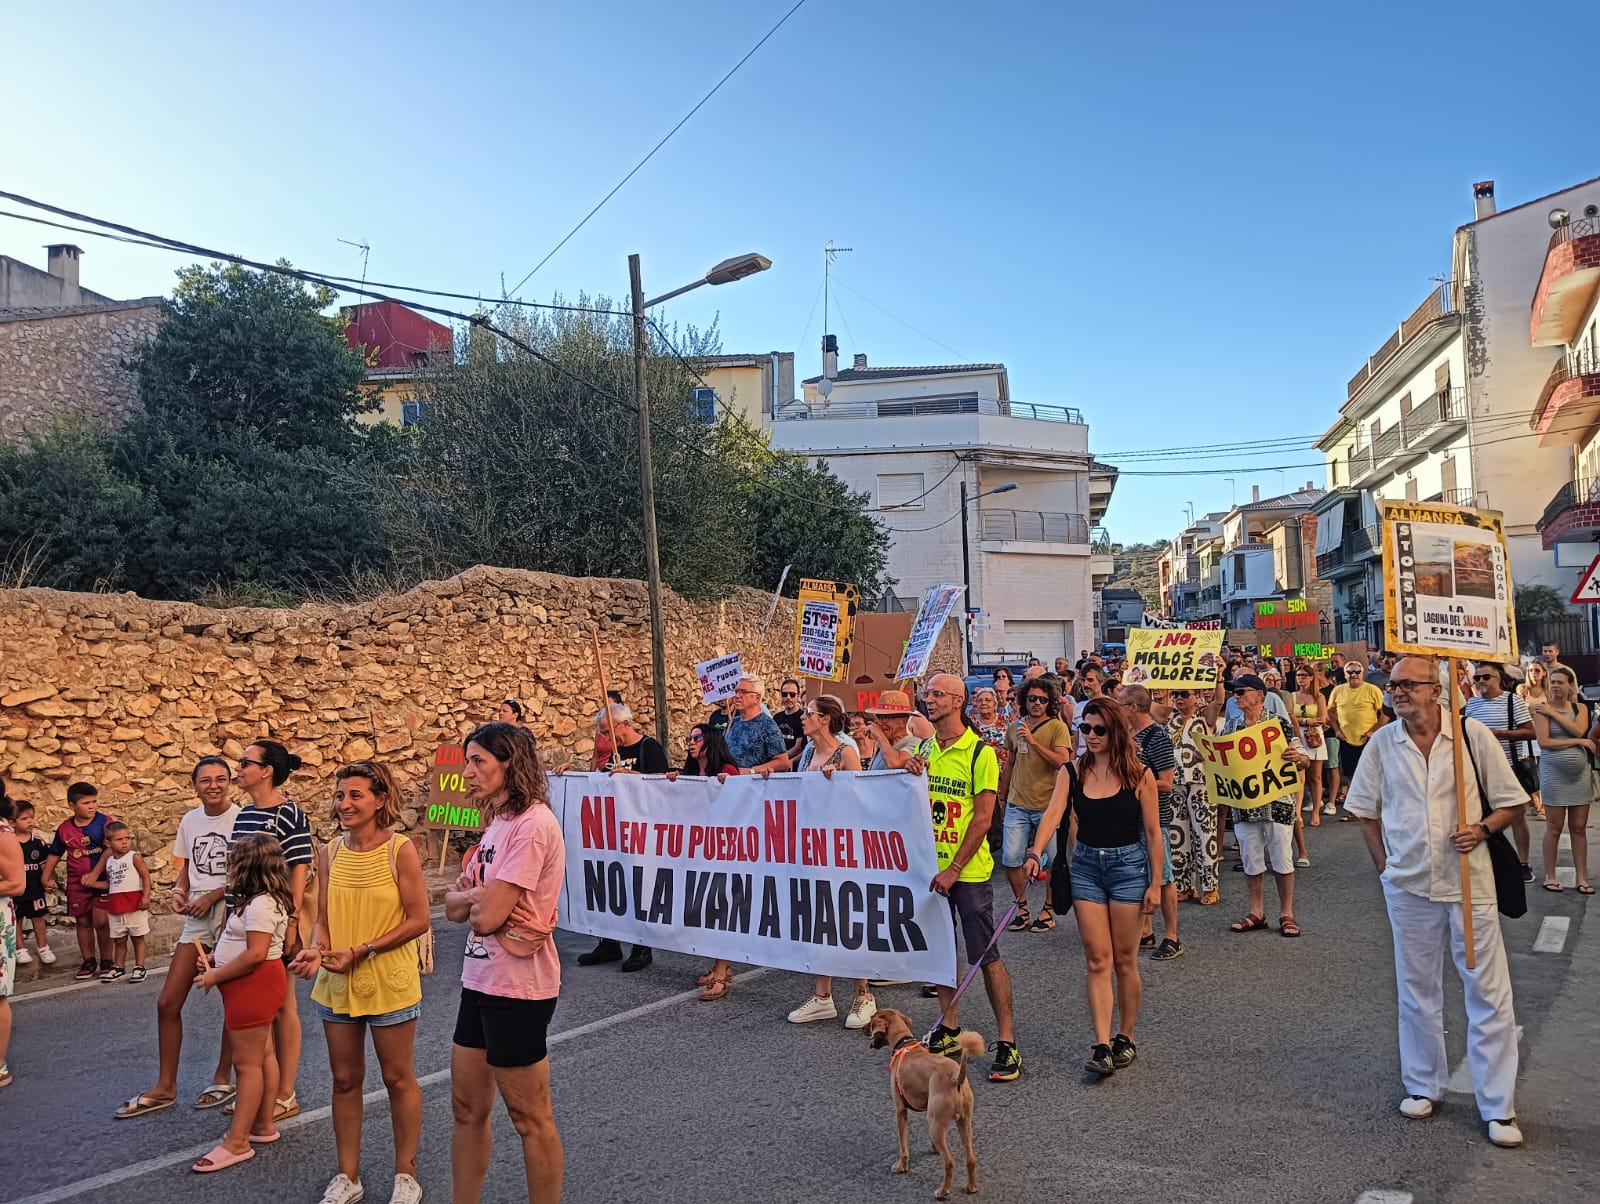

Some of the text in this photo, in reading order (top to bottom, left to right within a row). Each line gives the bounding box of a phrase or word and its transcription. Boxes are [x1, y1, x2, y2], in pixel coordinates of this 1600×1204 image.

[1389, 508, 1464, 525] ALMANSA
[1494, 546, 1505, 600] BIOGAS
[1258, 599, 1308, 615] NO SOM
[1449, 605, 1464, 613] LA
[1423, 612, 1489, 629] LAGUNA DEL SALADAR
[1431, 627, 1483, 638] EXISTE
[1260, 642, 1321, 657] DE LA MERDA
[806, 657, 825, 671] NO
[1134, 651, 1194, 666] MALOS
[1151, 667, 1217, 682] OLORES
[1201, 726, 1281, 767] STOP
[580, 795, 909, 872] NI EN TU PUEBLO NI EN EL MIO
[583, 859, 929, 953] NO LA VAN A HACER
